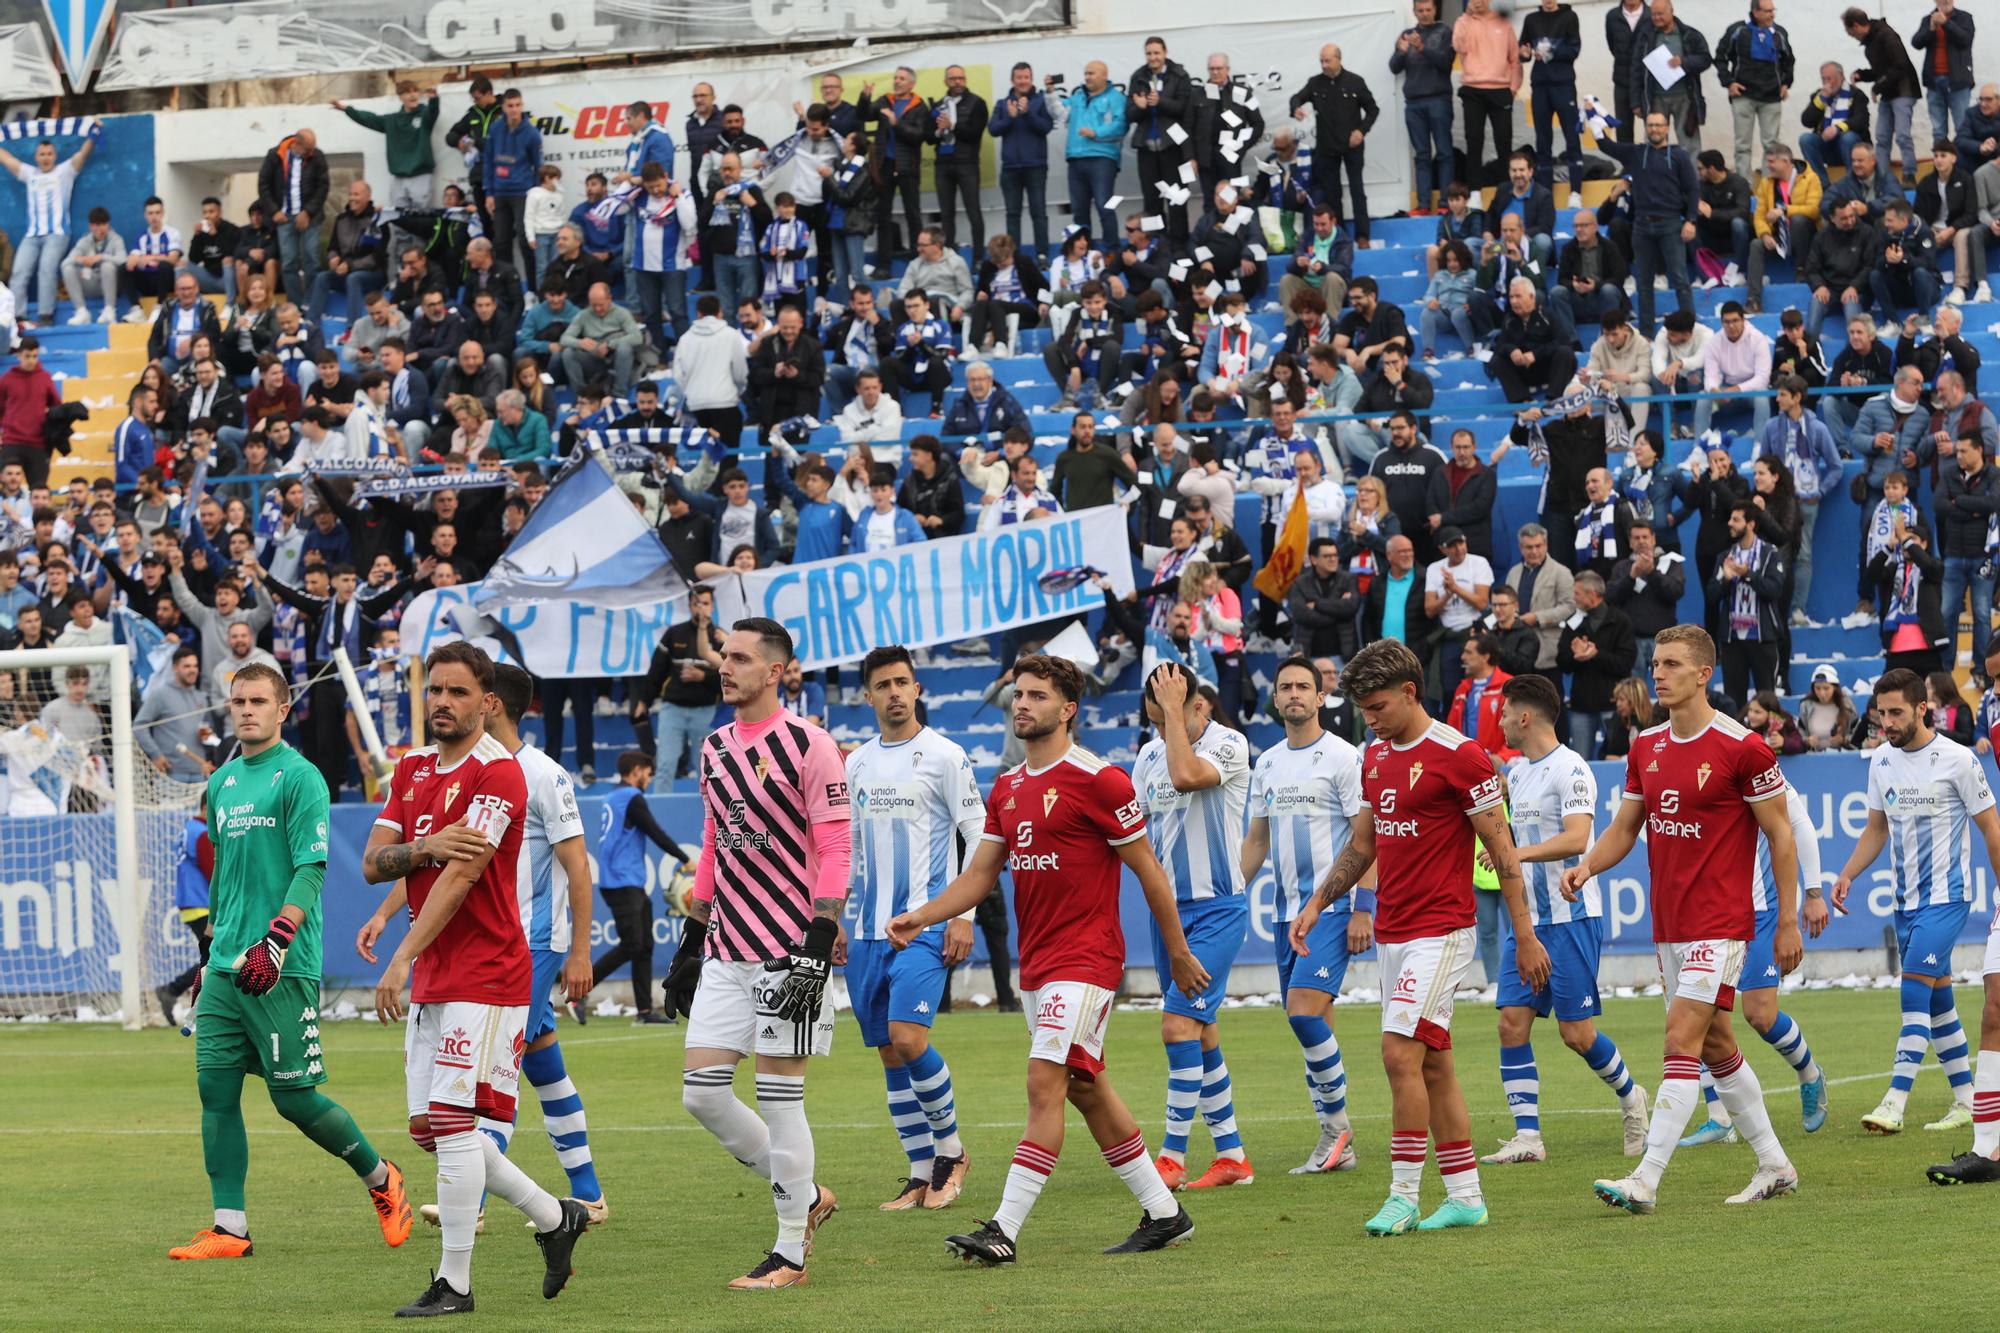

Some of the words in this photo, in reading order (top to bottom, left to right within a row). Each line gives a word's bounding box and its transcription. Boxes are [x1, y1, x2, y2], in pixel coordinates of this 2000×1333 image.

[1384, 462, 1426, 475] adidas
[406, 473, 498, 488] ALCOYANO
[763, 552, 922, 664] GARRA
[929, 548, 945, 638] I
[960, 518, 1105, 633] MORAL
[871, 786, 896, 796] unión
[1899, 787, 1919, 796] unión
[870, 797, 914, 808] alcoyana
[1276, 794, 1315, 806] alcoyana
[1898, 796, 1934, 806] alcoyana
[229, 801, 254, 816] unión
[227, 814, 276, 831] alcoyana
[270, 1032, 280, 1063] 1
